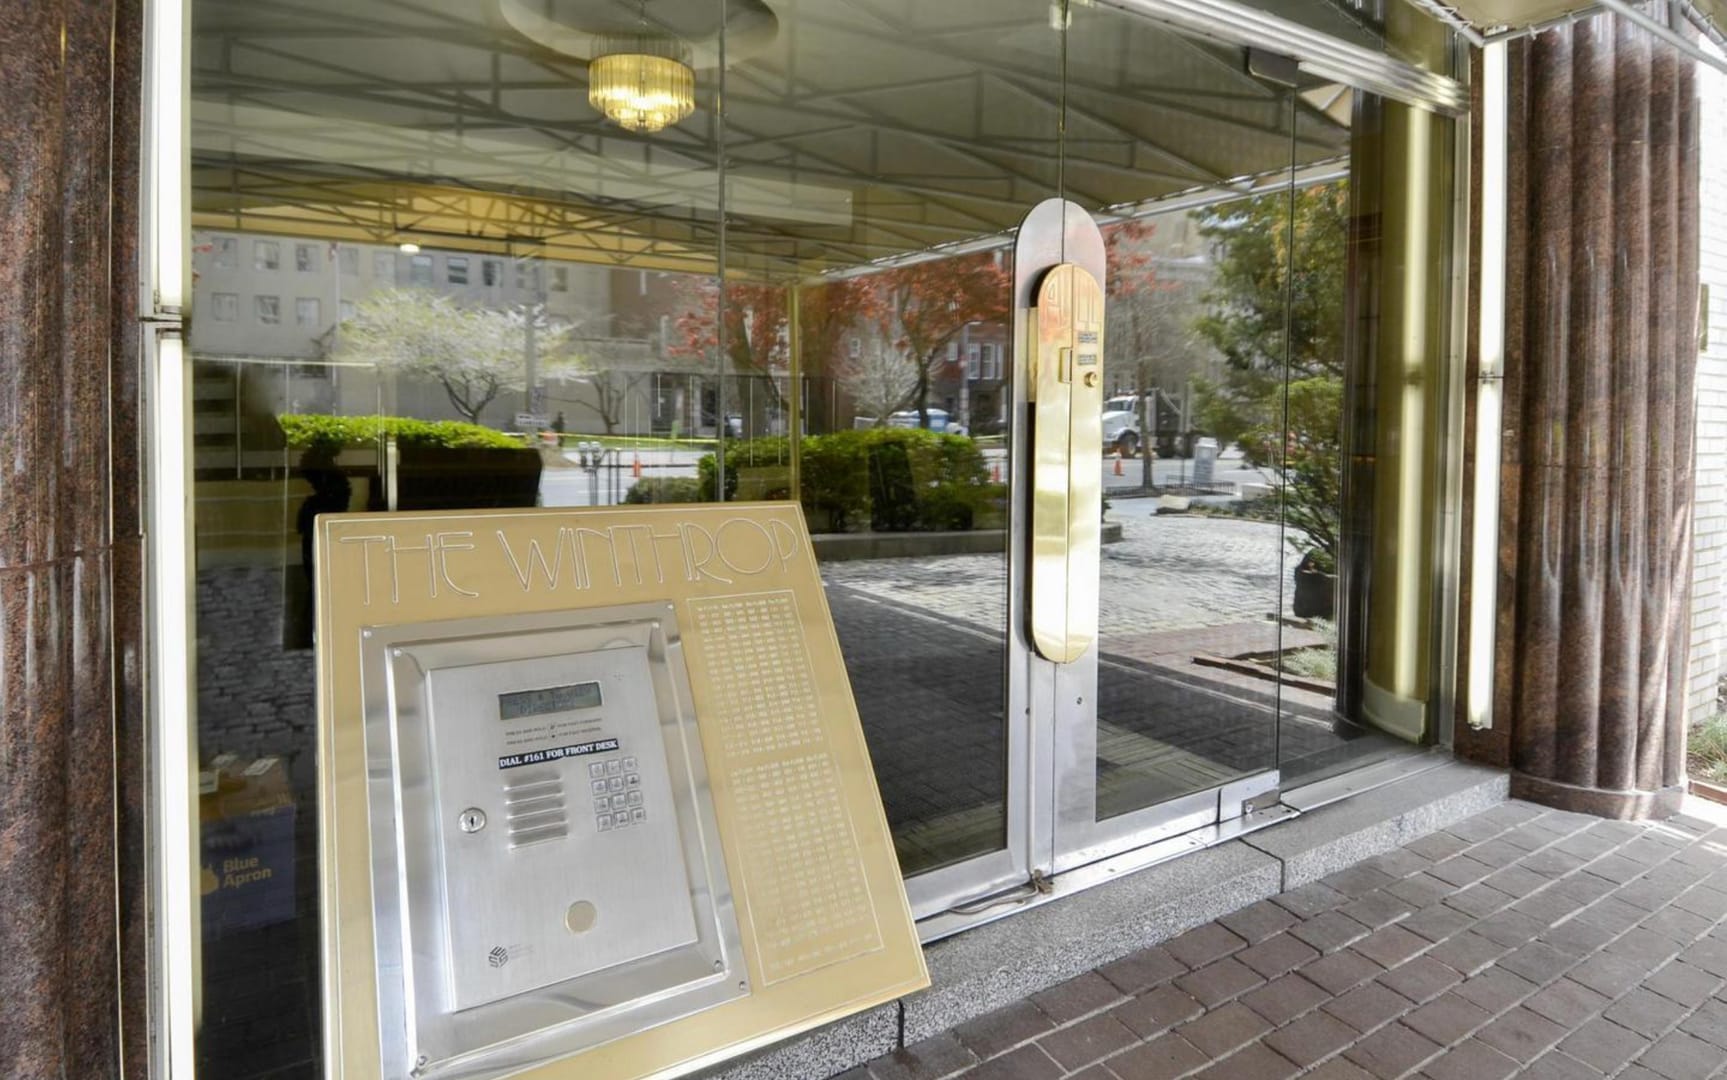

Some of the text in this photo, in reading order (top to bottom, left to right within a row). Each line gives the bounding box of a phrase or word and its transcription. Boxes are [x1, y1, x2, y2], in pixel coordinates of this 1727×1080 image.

[340, 518, 798, 606] THE WINTHROP
[500, 740, 618, 768] DIAL #161 FOR FRONT DESK
[223, 856, 259, 873] Blue
[223, 866, 272, 889] Apron
